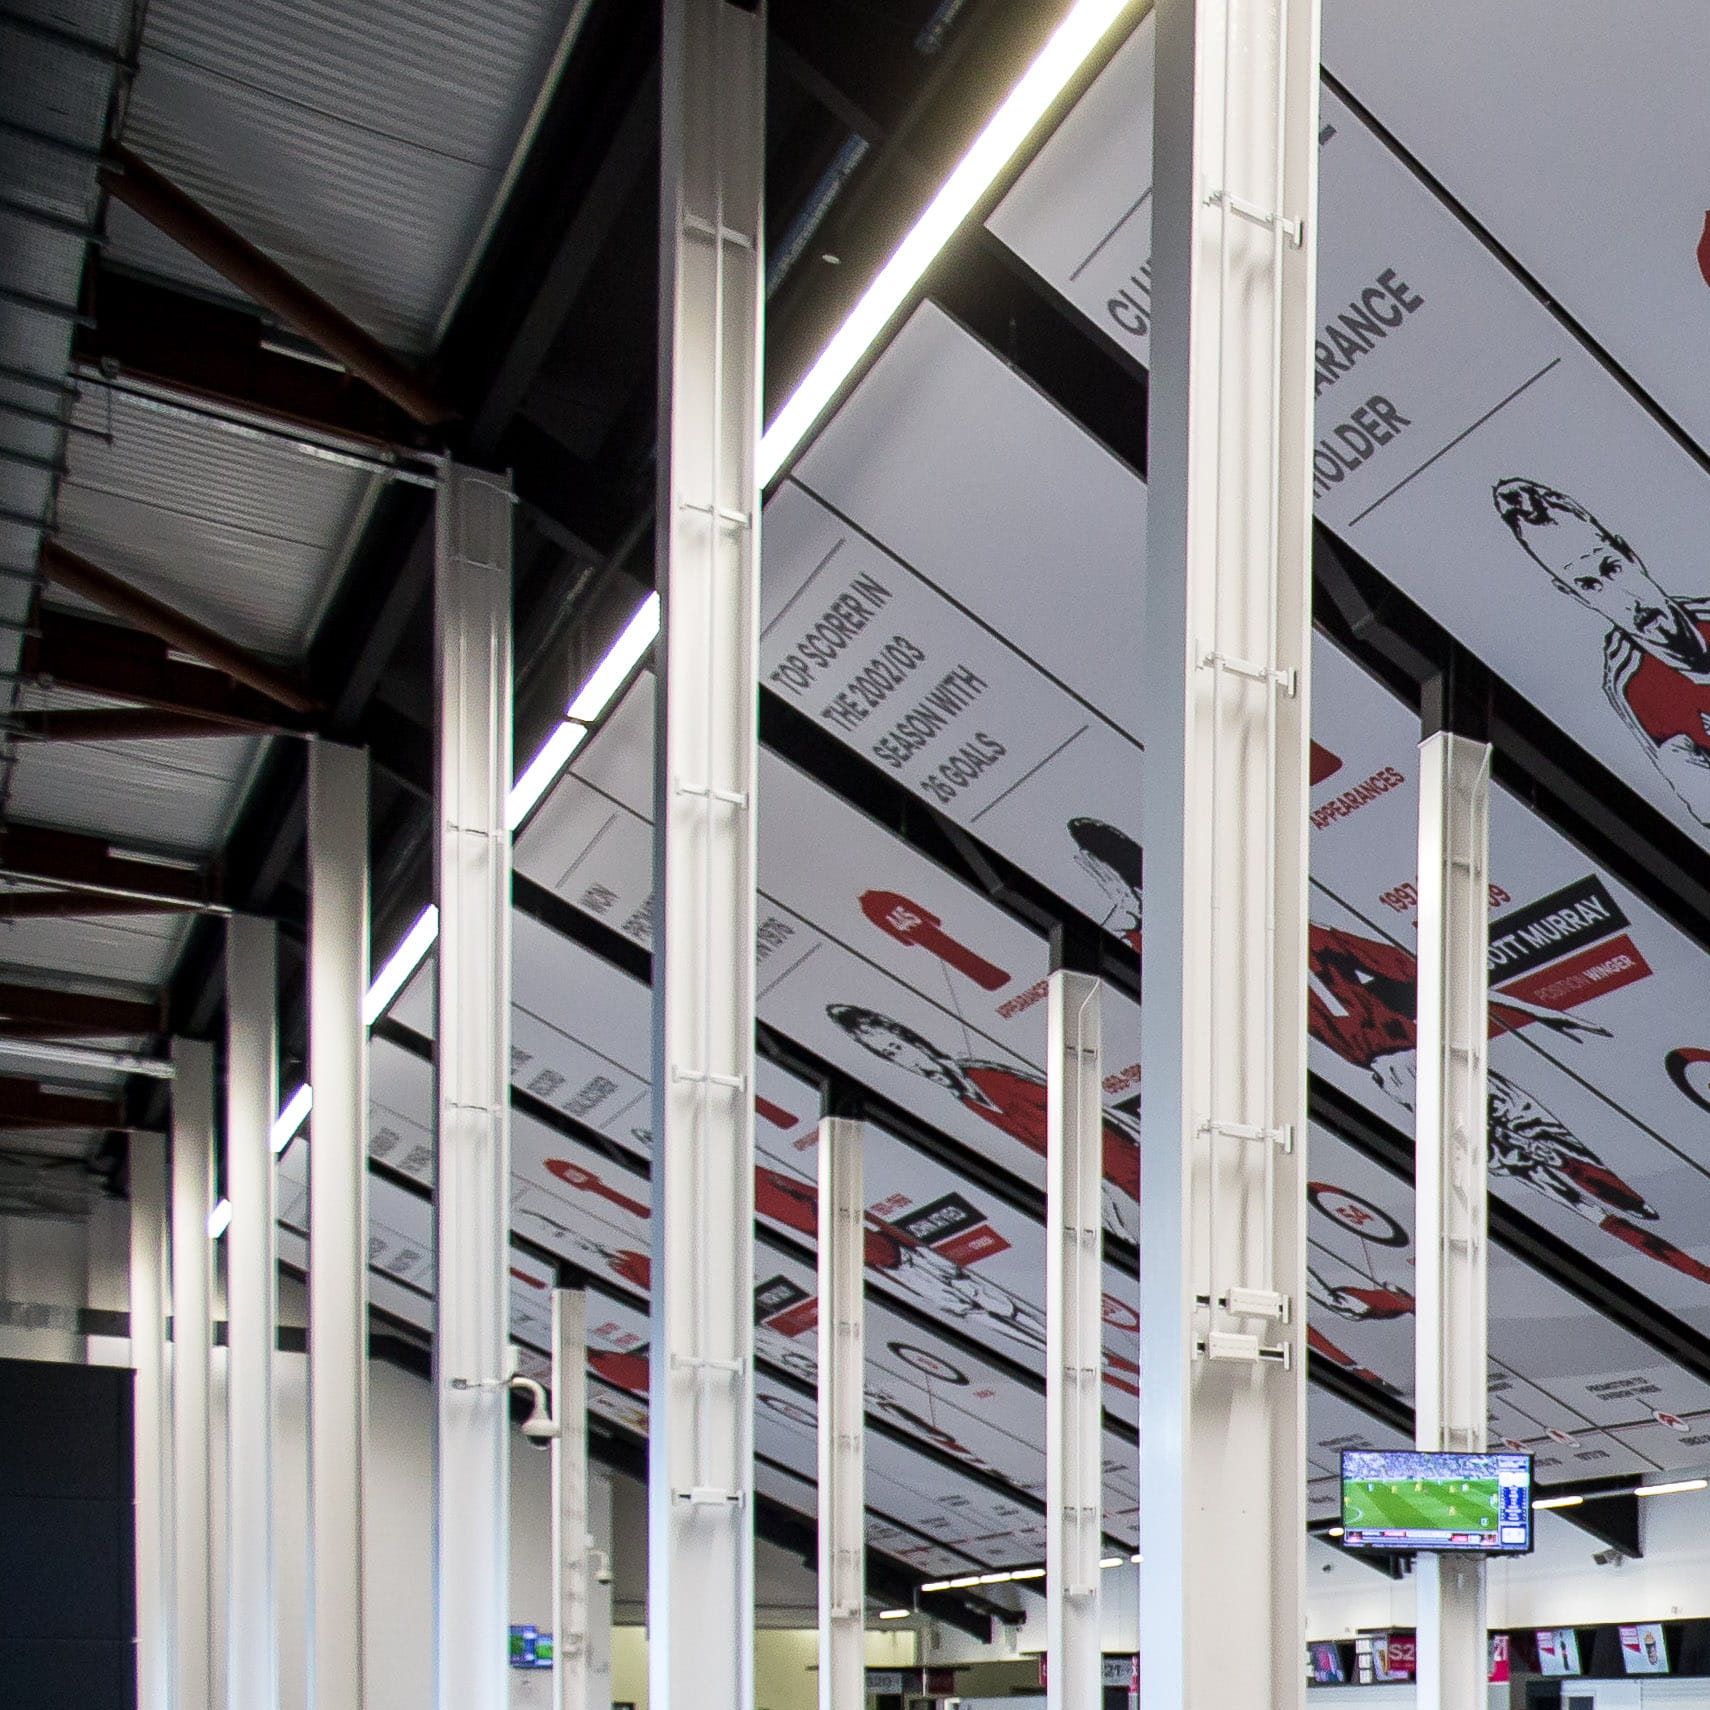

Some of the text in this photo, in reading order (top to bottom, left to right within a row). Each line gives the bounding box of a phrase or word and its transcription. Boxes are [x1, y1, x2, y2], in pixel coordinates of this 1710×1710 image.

[770, 571, 893, 696] TOP SCORER IN
[821, 635, 926, 732] THE 2002/03
[872, 664, 989, 769] SEASON WITH
[939, 731, 1008, 788] GOALS
[1310, 766, 1405, 830] APPEARANCES
[1489, 895, 1611, 970] OTT MURRAY
[1583, 954, 1636, 981] WINGER
